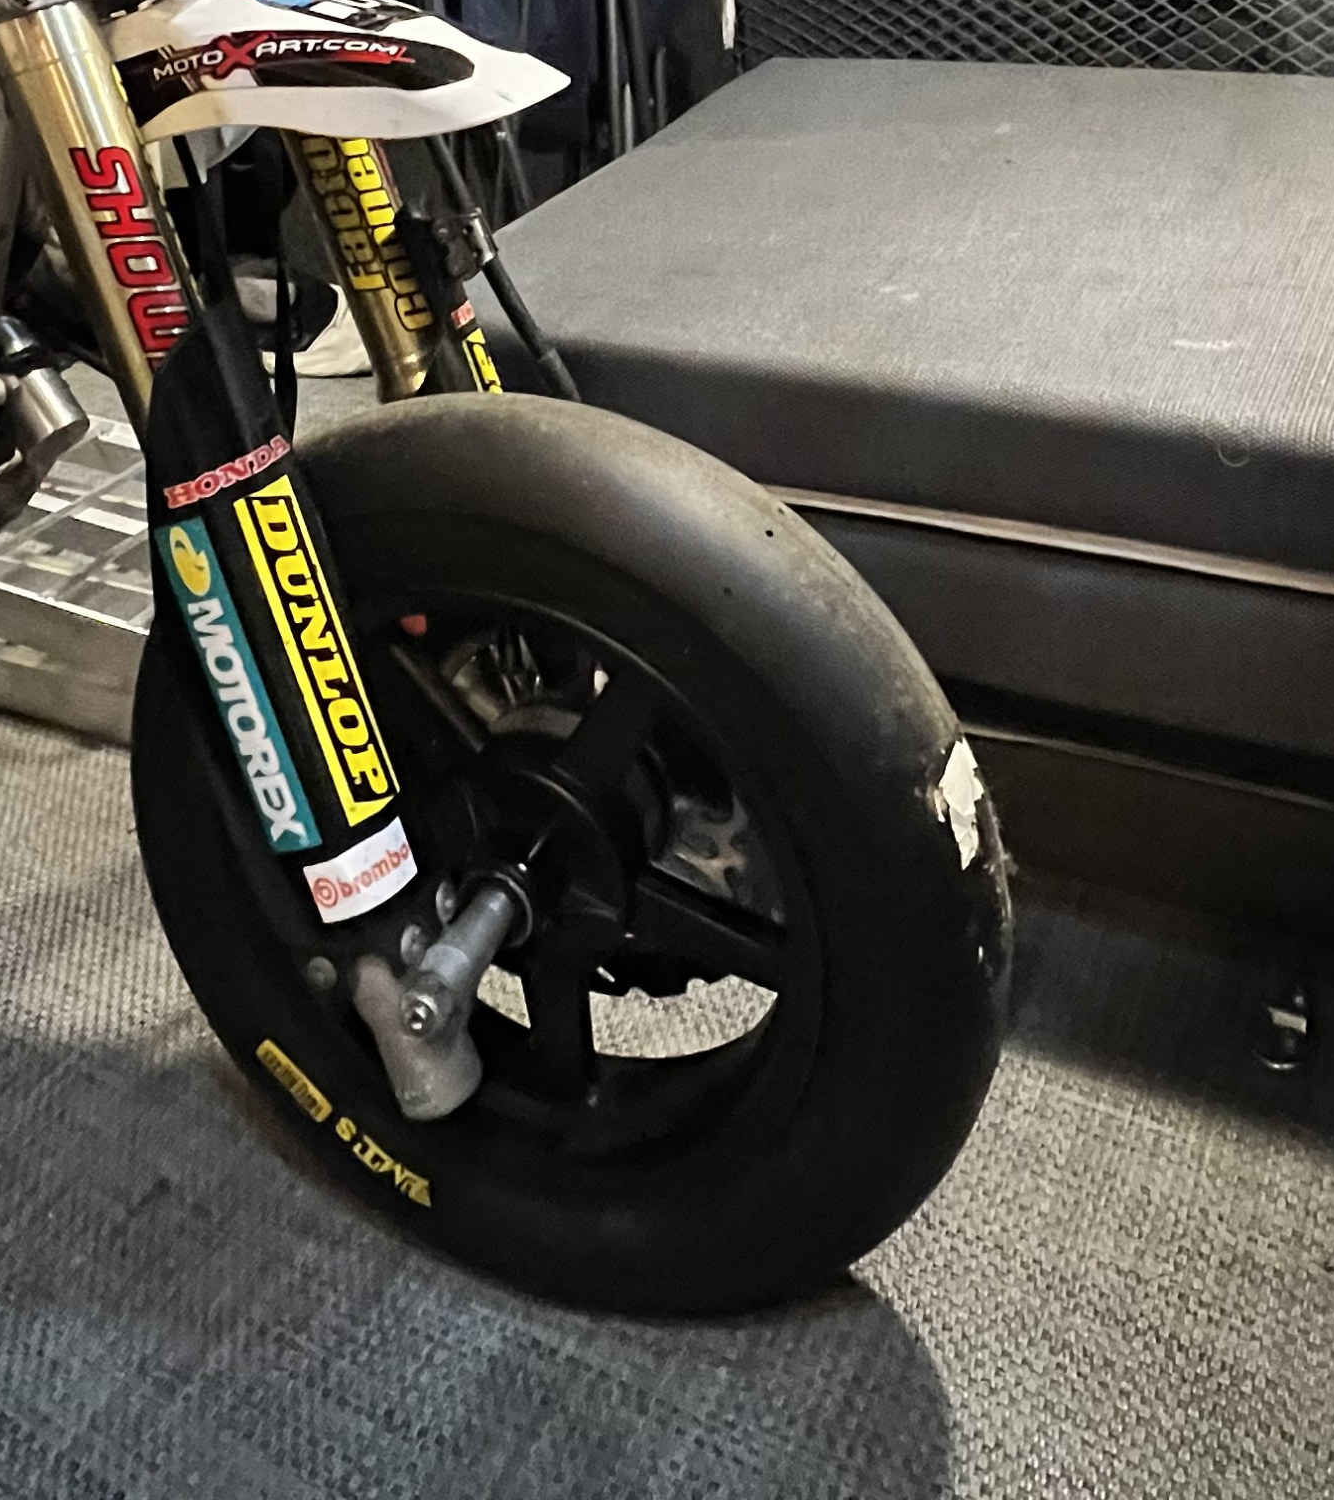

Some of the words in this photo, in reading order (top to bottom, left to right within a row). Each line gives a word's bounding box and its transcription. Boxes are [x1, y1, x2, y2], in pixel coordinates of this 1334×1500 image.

[152, 31, 399, 81] MOTOXART.COM
[68, 146, 192, 375] SHOW
[164, 435, 291, 508] HONDA
[186, 597, 305, 843] MOTOREX
[254, 497, 389, 797] DUNLOP
